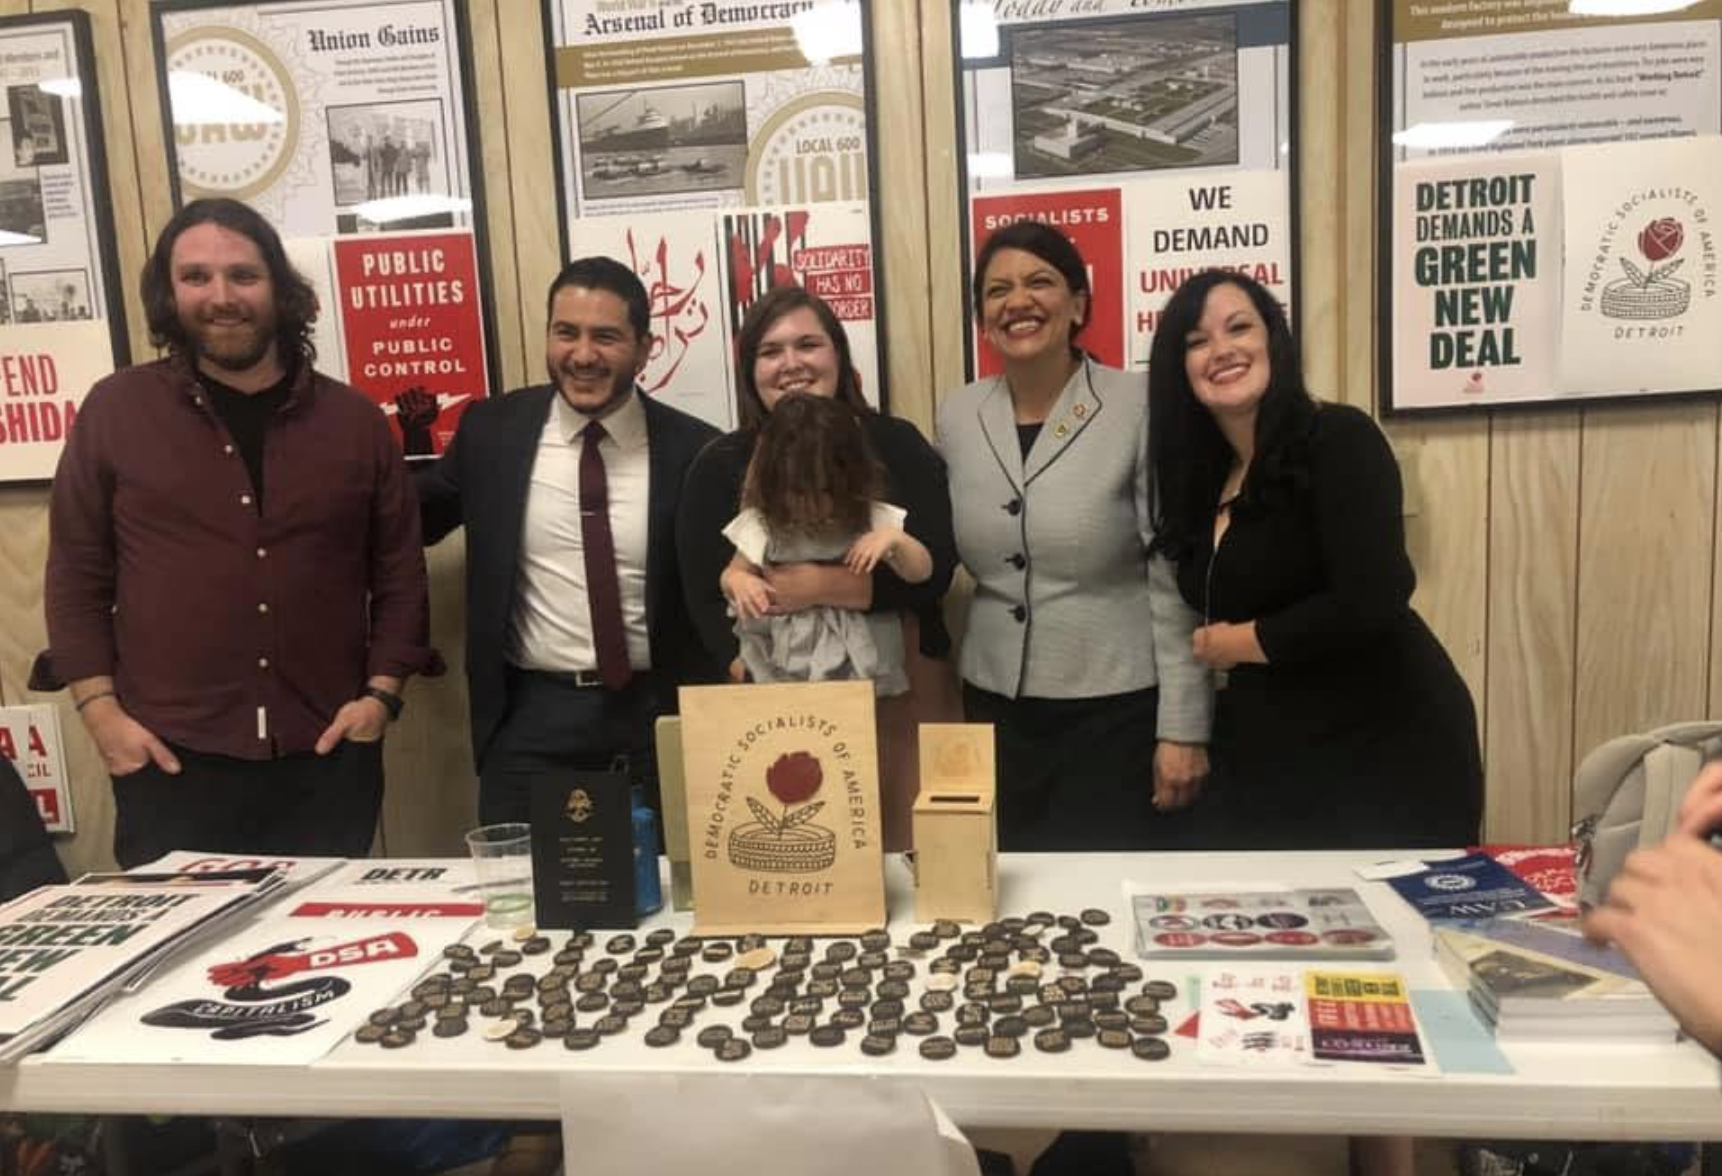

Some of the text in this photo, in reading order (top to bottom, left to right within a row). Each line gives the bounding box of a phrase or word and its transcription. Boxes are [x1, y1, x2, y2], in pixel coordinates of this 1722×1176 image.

[583, 9, 665, 36] Arsenal
[673, 4, 696, 28] of
[307, 24, 440, 51] Union Gains
[796, 135, 861, 154] LOCAL 600
[1189, 186, 1232, 211] WE
[1416, 174, 1536, 212] DETROIT
[1416, 207, 1535, 242] DEMANDS A
[1153, 224, 1269, 254] DEMAND
[1580, 221, 1619, 312] DEMOCRATIC
[1615, 187, 1698, 220] SOCIALISTS
[1699, 231, 1717, 298] AMERICA
[362, 249, 445, 277] PUBLIC
[797, 249, 868, 270] SOLIDARITY
[1414, 239, 1537, 287] GREEN
[816, 272, 862, 293] HAS NO
[1140, 262, 1284, 294] UNIAL
[350, 280, 464, 309] UTILITIES
[830, 298, 869, 318] ORDER
[1434, 285, 1515, 327] NEW
[389, 315, 431, 330] under
[1613, 326, 1685, 340] DETROIT
[372, 337, 453, 355] PUBLIC
[1430, 328, 1521, 370] DEAL
[364, 359, 467, 377] CONTROL
[704, 715, 868, 860] DEMOCRATIC SOCIALISTS OF AMERICA
[748, 879, 834, 896] DETROIT
[0, 949, 84, 973] EW
[309, 938, 398, 968] DSA
[194, 989, 334, 1017] CAPITALISM
